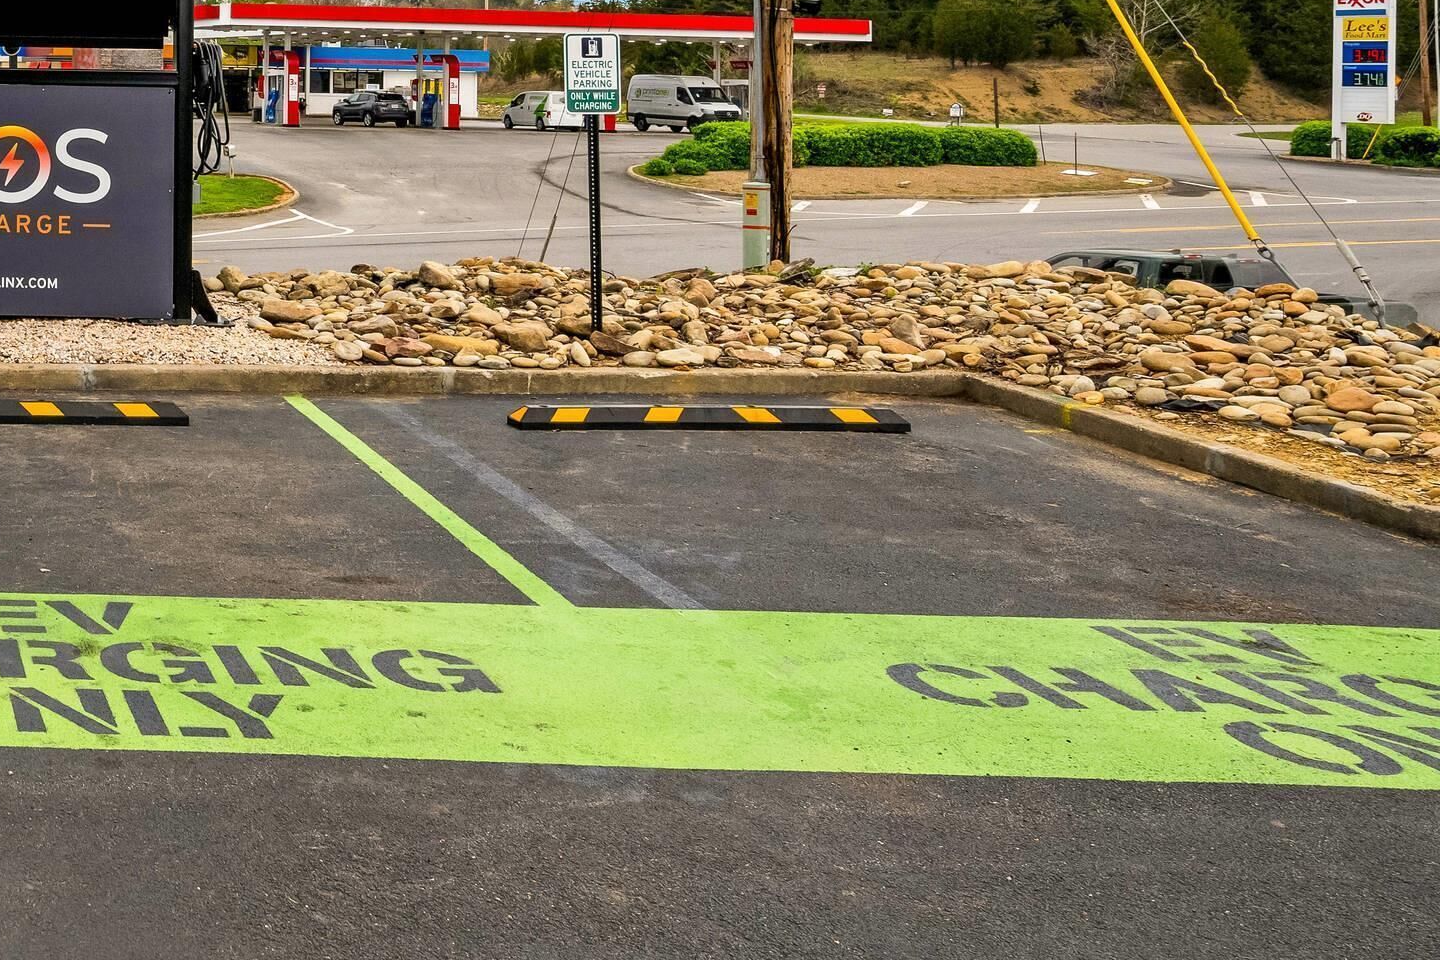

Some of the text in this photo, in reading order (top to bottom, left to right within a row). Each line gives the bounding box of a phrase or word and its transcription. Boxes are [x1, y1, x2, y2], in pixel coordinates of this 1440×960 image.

[1345, 19, 1387, 32] Lee's
[1366, 31, 1386, 39] Mart
[571, 60, 613, 69] ELECTRIC
[574, 70, 612, 79] VEHICLE
[573, 79, 613, 88] PARKING
[570, 92, 616, 101] ONLY WHILE
[574, 101, 613, 110] CHARGING
[1090, 625, 1322, 667] EV
